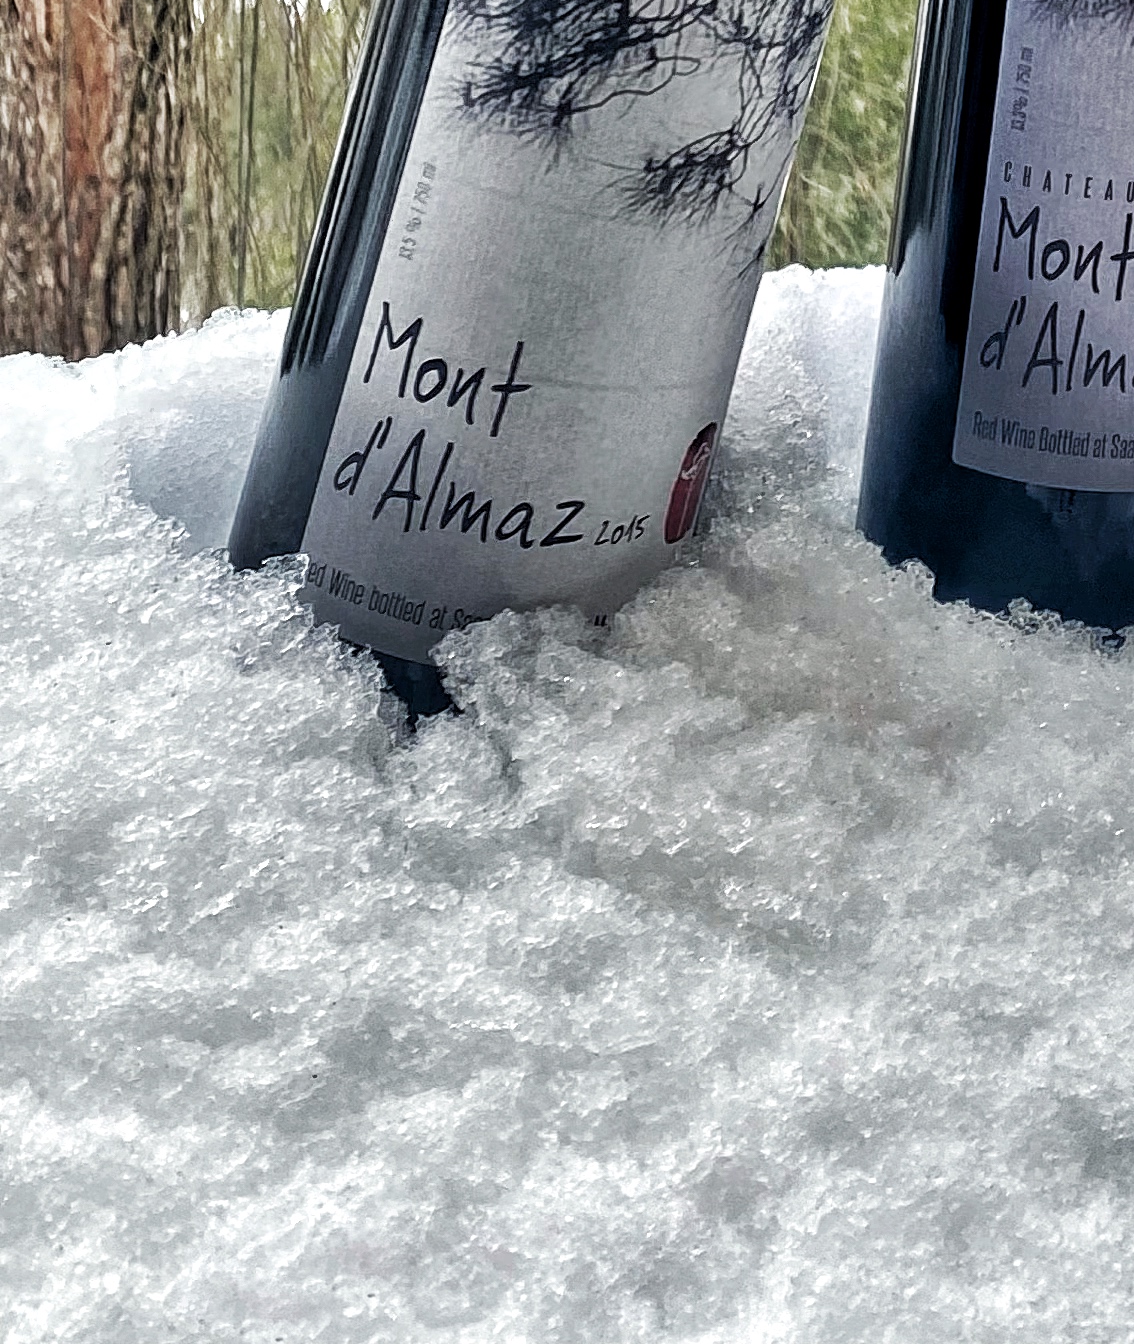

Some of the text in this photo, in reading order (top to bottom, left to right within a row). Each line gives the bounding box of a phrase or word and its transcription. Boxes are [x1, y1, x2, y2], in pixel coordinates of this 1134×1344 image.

[362, 301, 533, 437] Mont
[333, 415, 652, 550] d'Almaz 2015
[972, 410, 998, 441] Red
[1001, 417, 1036, 449] Wine
[1038, 426, 1091, 458] Bottled
[1093, 433, 1108, 459] at
[306, 562, 328, 588] ed
[328, 566, 365, 605] Wine
[428, 605, 449, 631] at
